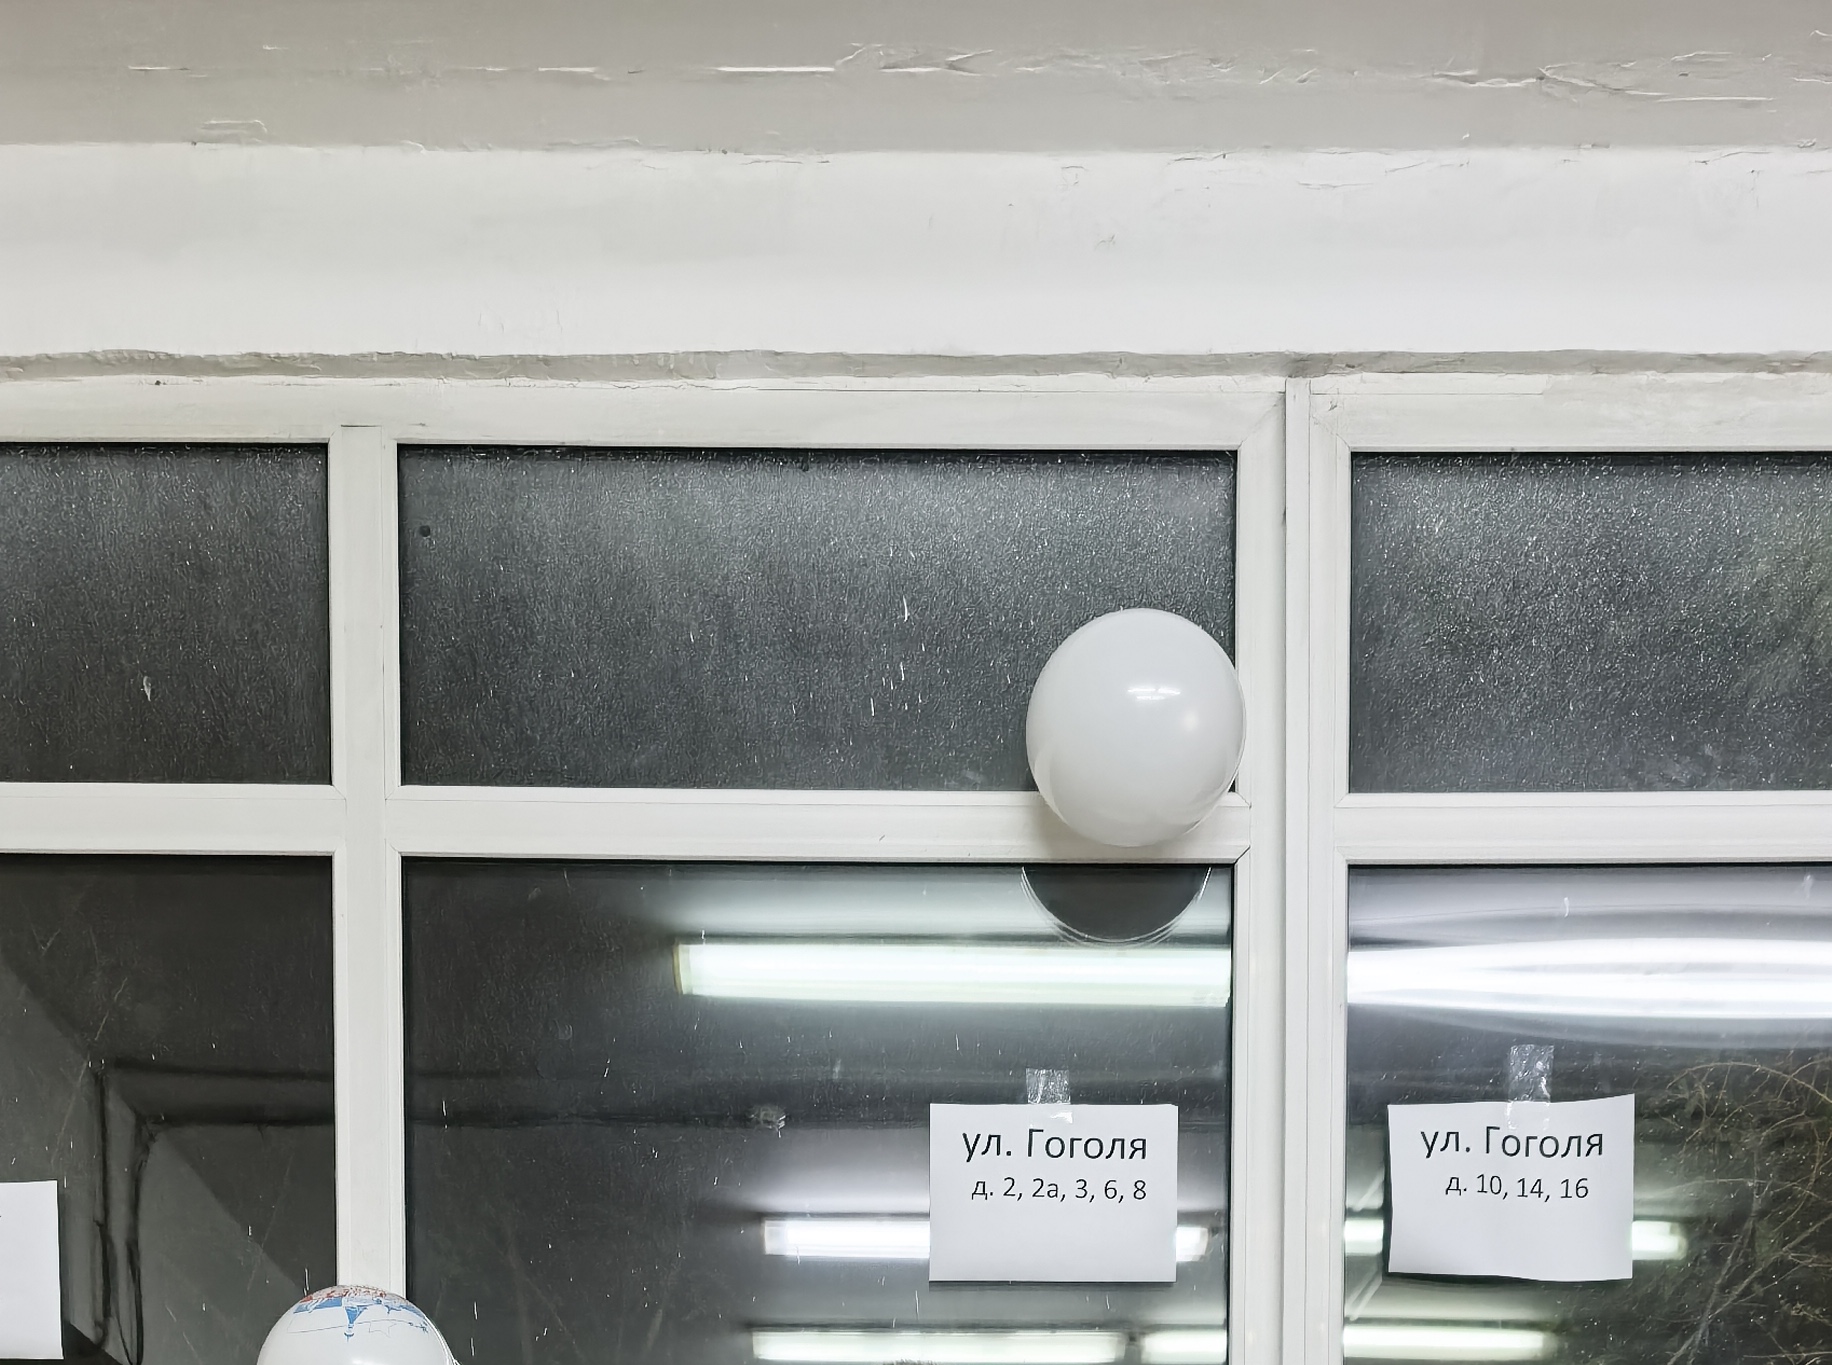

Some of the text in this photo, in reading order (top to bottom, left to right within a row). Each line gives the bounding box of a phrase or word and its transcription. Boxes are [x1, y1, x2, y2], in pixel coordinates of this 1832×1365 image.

[962, 1128, 1147, 1163] ул. Гоголя
[1420, 1125, 1603, 1160] ул. Гоголя
[971, 1177, 1147, 1204] д. 2, 2а, 3, 6, 8
[1445, 1174, 1589, 1203] д. 10, 14, 16
